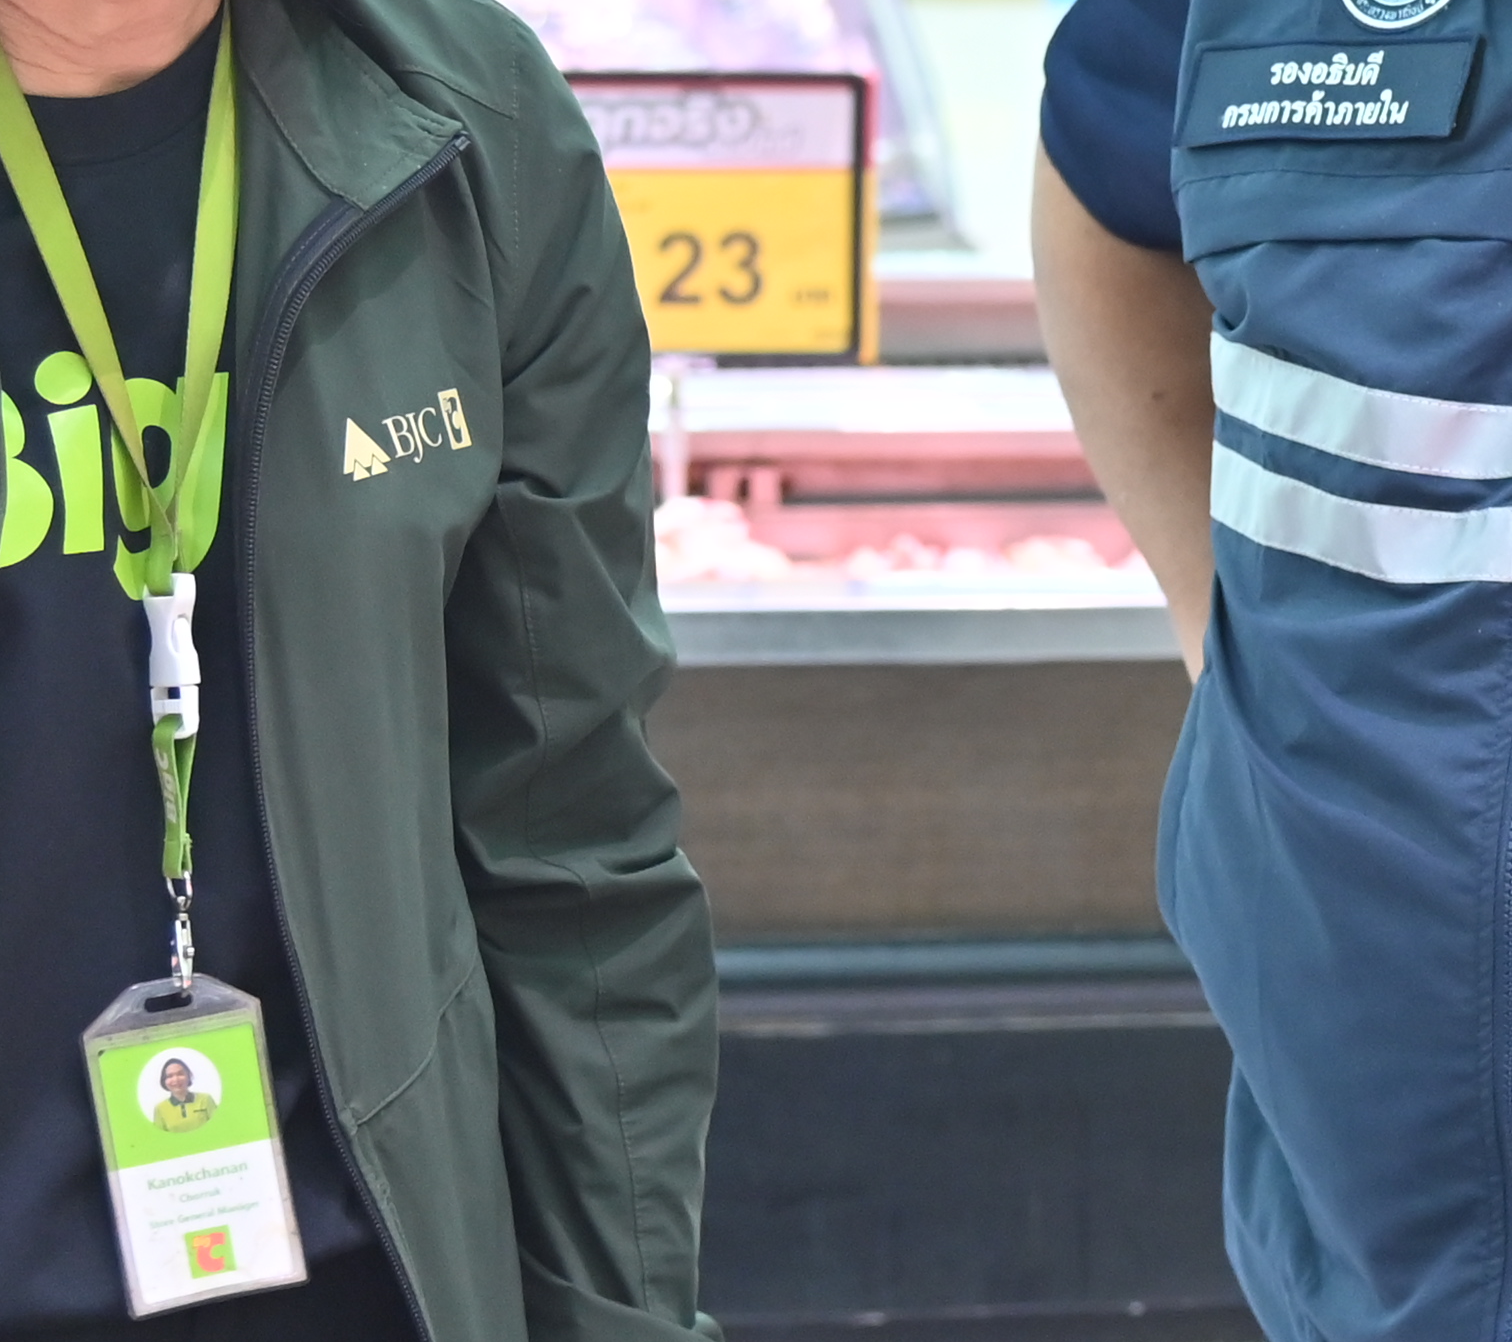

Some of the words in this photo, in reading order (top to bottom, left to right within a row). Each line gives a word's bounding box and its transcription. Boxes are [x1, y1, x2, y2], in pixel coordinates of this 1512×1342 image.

[1270, 50, 1385, 87] รองอธิบดี
[1221, 89, 1410, 129] กรมการค้าภายใน
[383, 406, 443, 465] BJC
